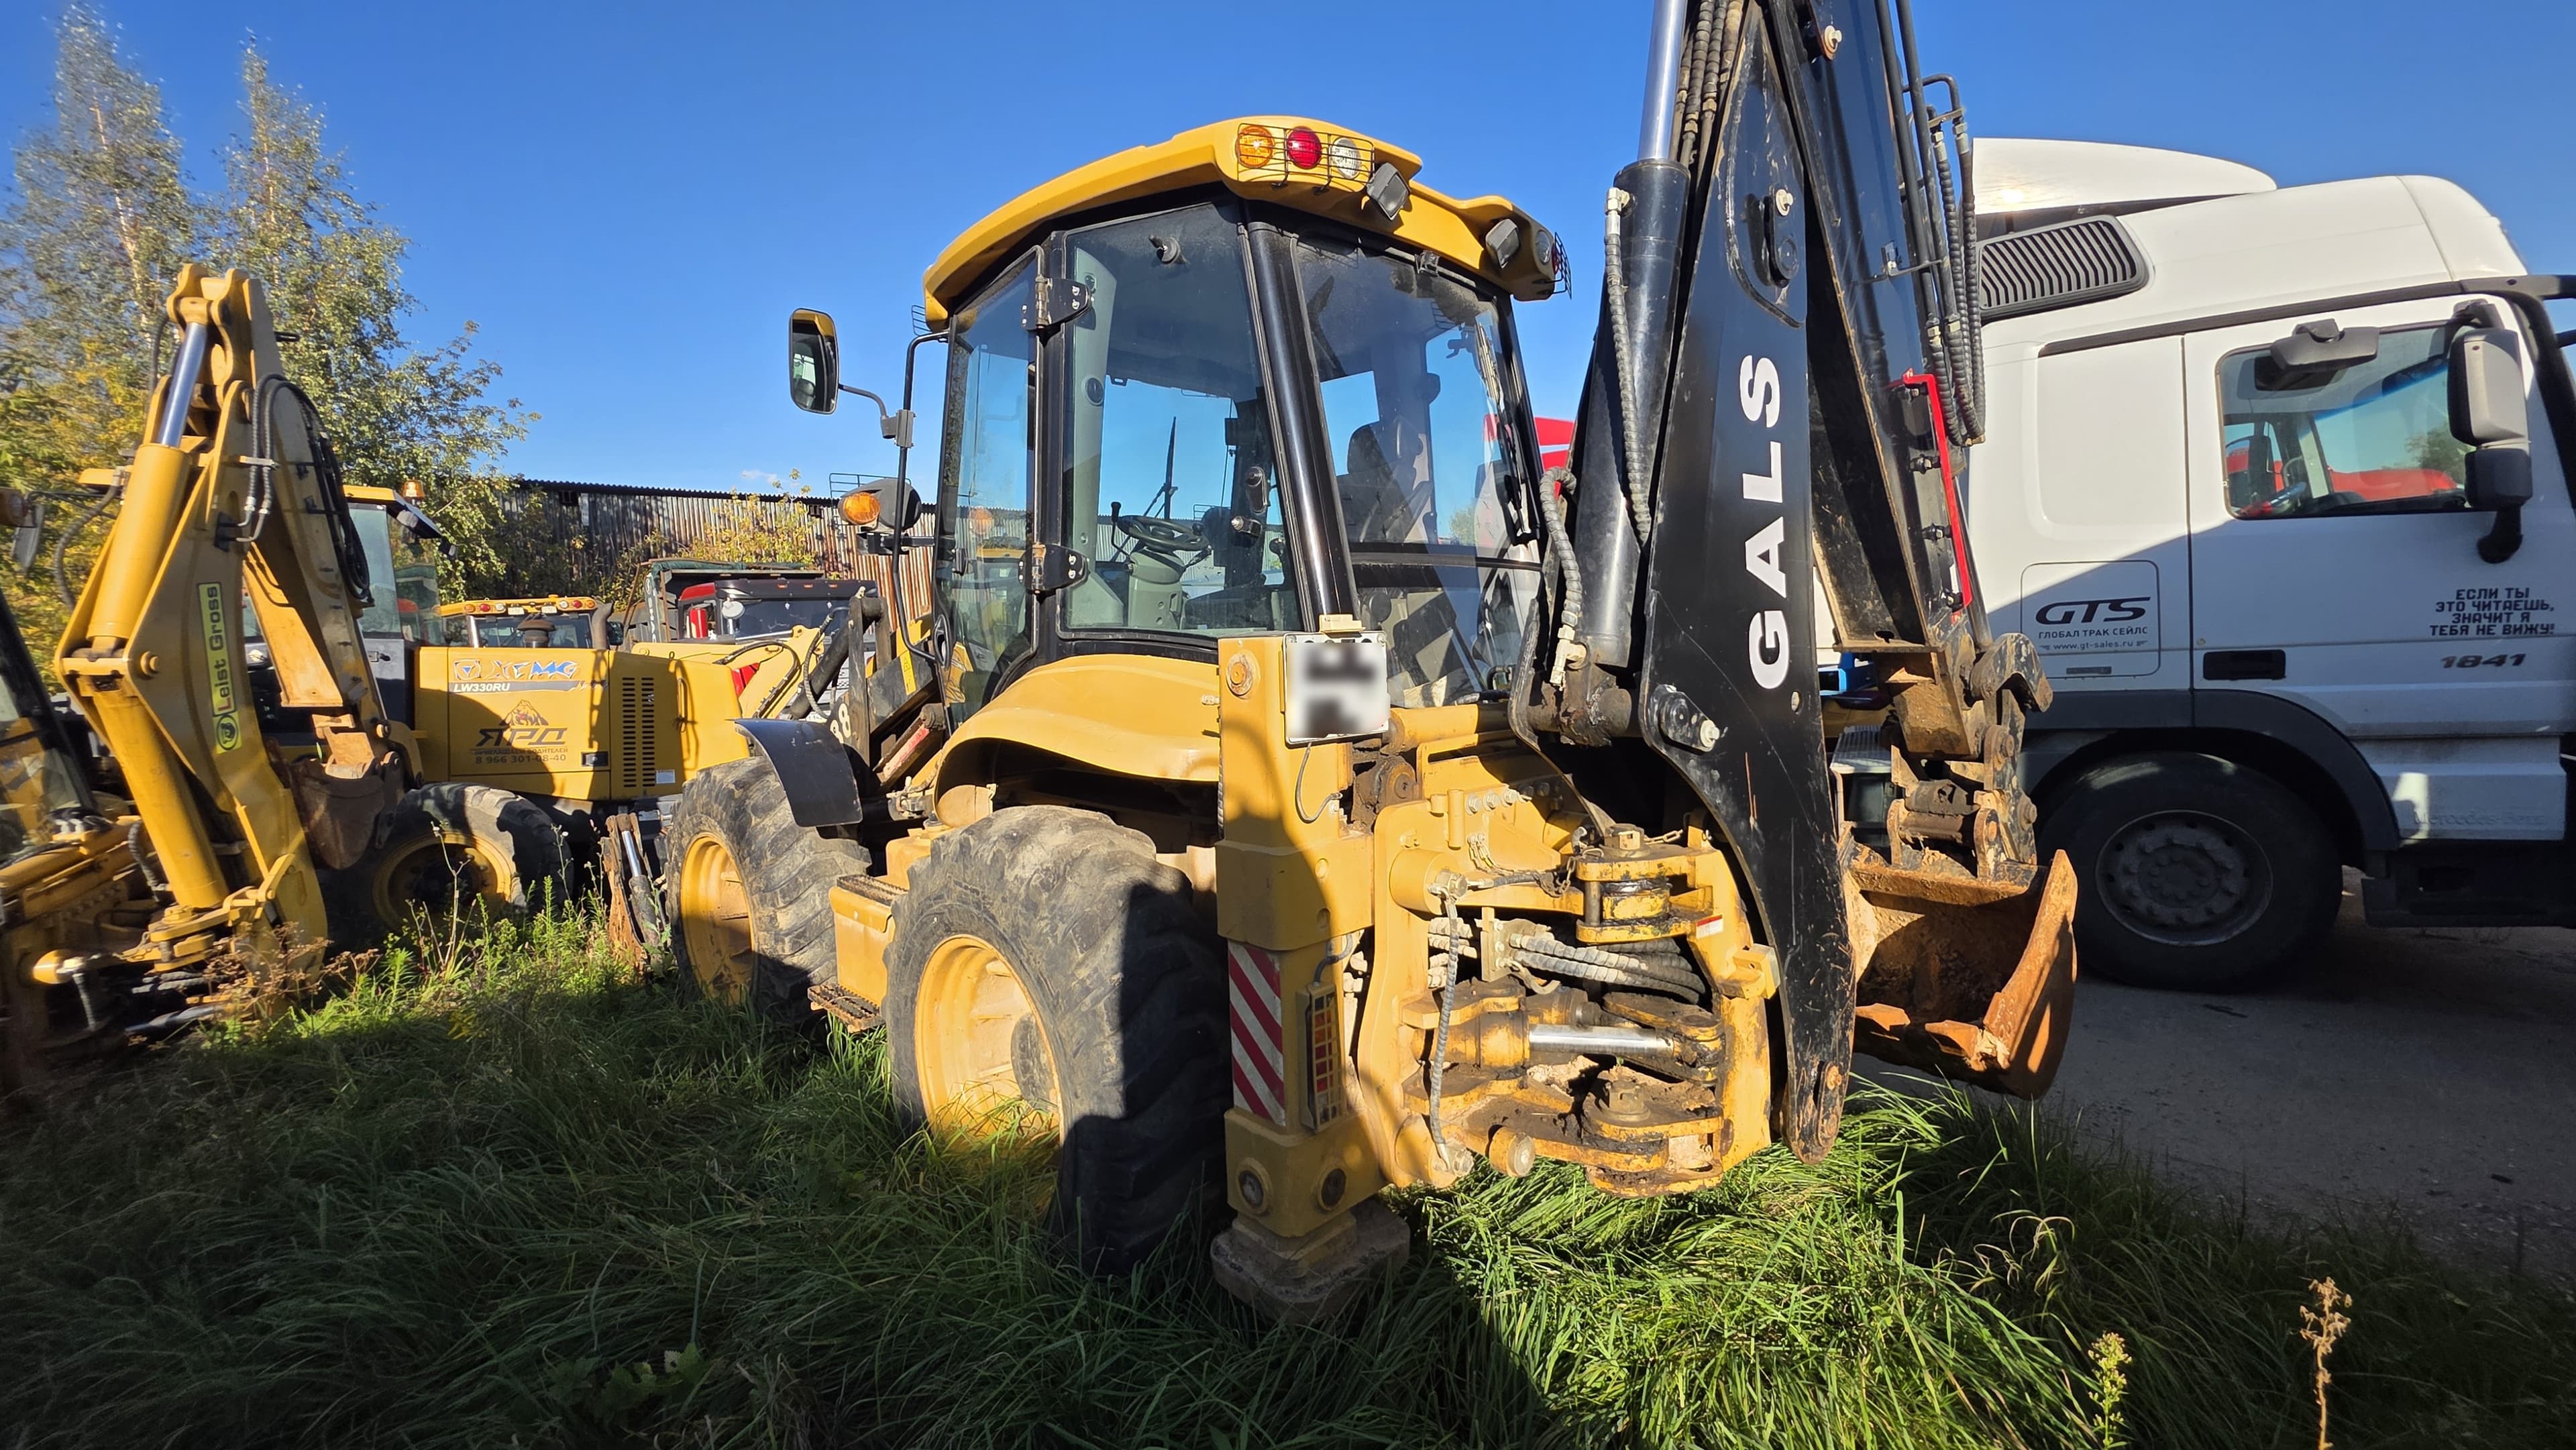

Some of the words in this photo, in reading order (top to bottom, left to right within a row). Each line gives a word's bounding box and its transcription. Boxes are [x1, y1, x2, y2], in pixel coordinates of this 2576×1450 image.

[1739, 354, 1790, 690] GALS
[2456, 588, 2499, 600] ЕСЛИ
[2505, 587, 2530, 598] ТЫ
[2035, 596, 2151, 625] GTS
[2435, 601, 2465, 612] ЭТО
[2472, 599, 2555, 612] ЧИТАЕШЬ,
[207, 587, 223, 651] Gross
[2452, 612, 2514, 624] ЗНАЧИТ
[2520, 612, 2530, 623] Я
[2039, 630, 2080, 639] ГЛОБАЛ
[2082, 628, 2110, 637] ТРАК
[2112, 626, 2148, 636] СЕЙЛС
[2430, 624, 2469, 636] ТЕБЯ
[2476, 624, 2496, 635] НЕ
[2502, 623, 2555, 635] ВИЖУ!
[2053, 640, 2134, 651] www.gt-sales.ru
[2440, 653, 2527, 669] 1841
[214, 658, 231, 712] Leist
[453, 682, 511, 693] LW330RU
[476, 727, 568, 747] ЯРД
[475, 756, 483, 764] 8
[486, 755, 508, 763] 966
